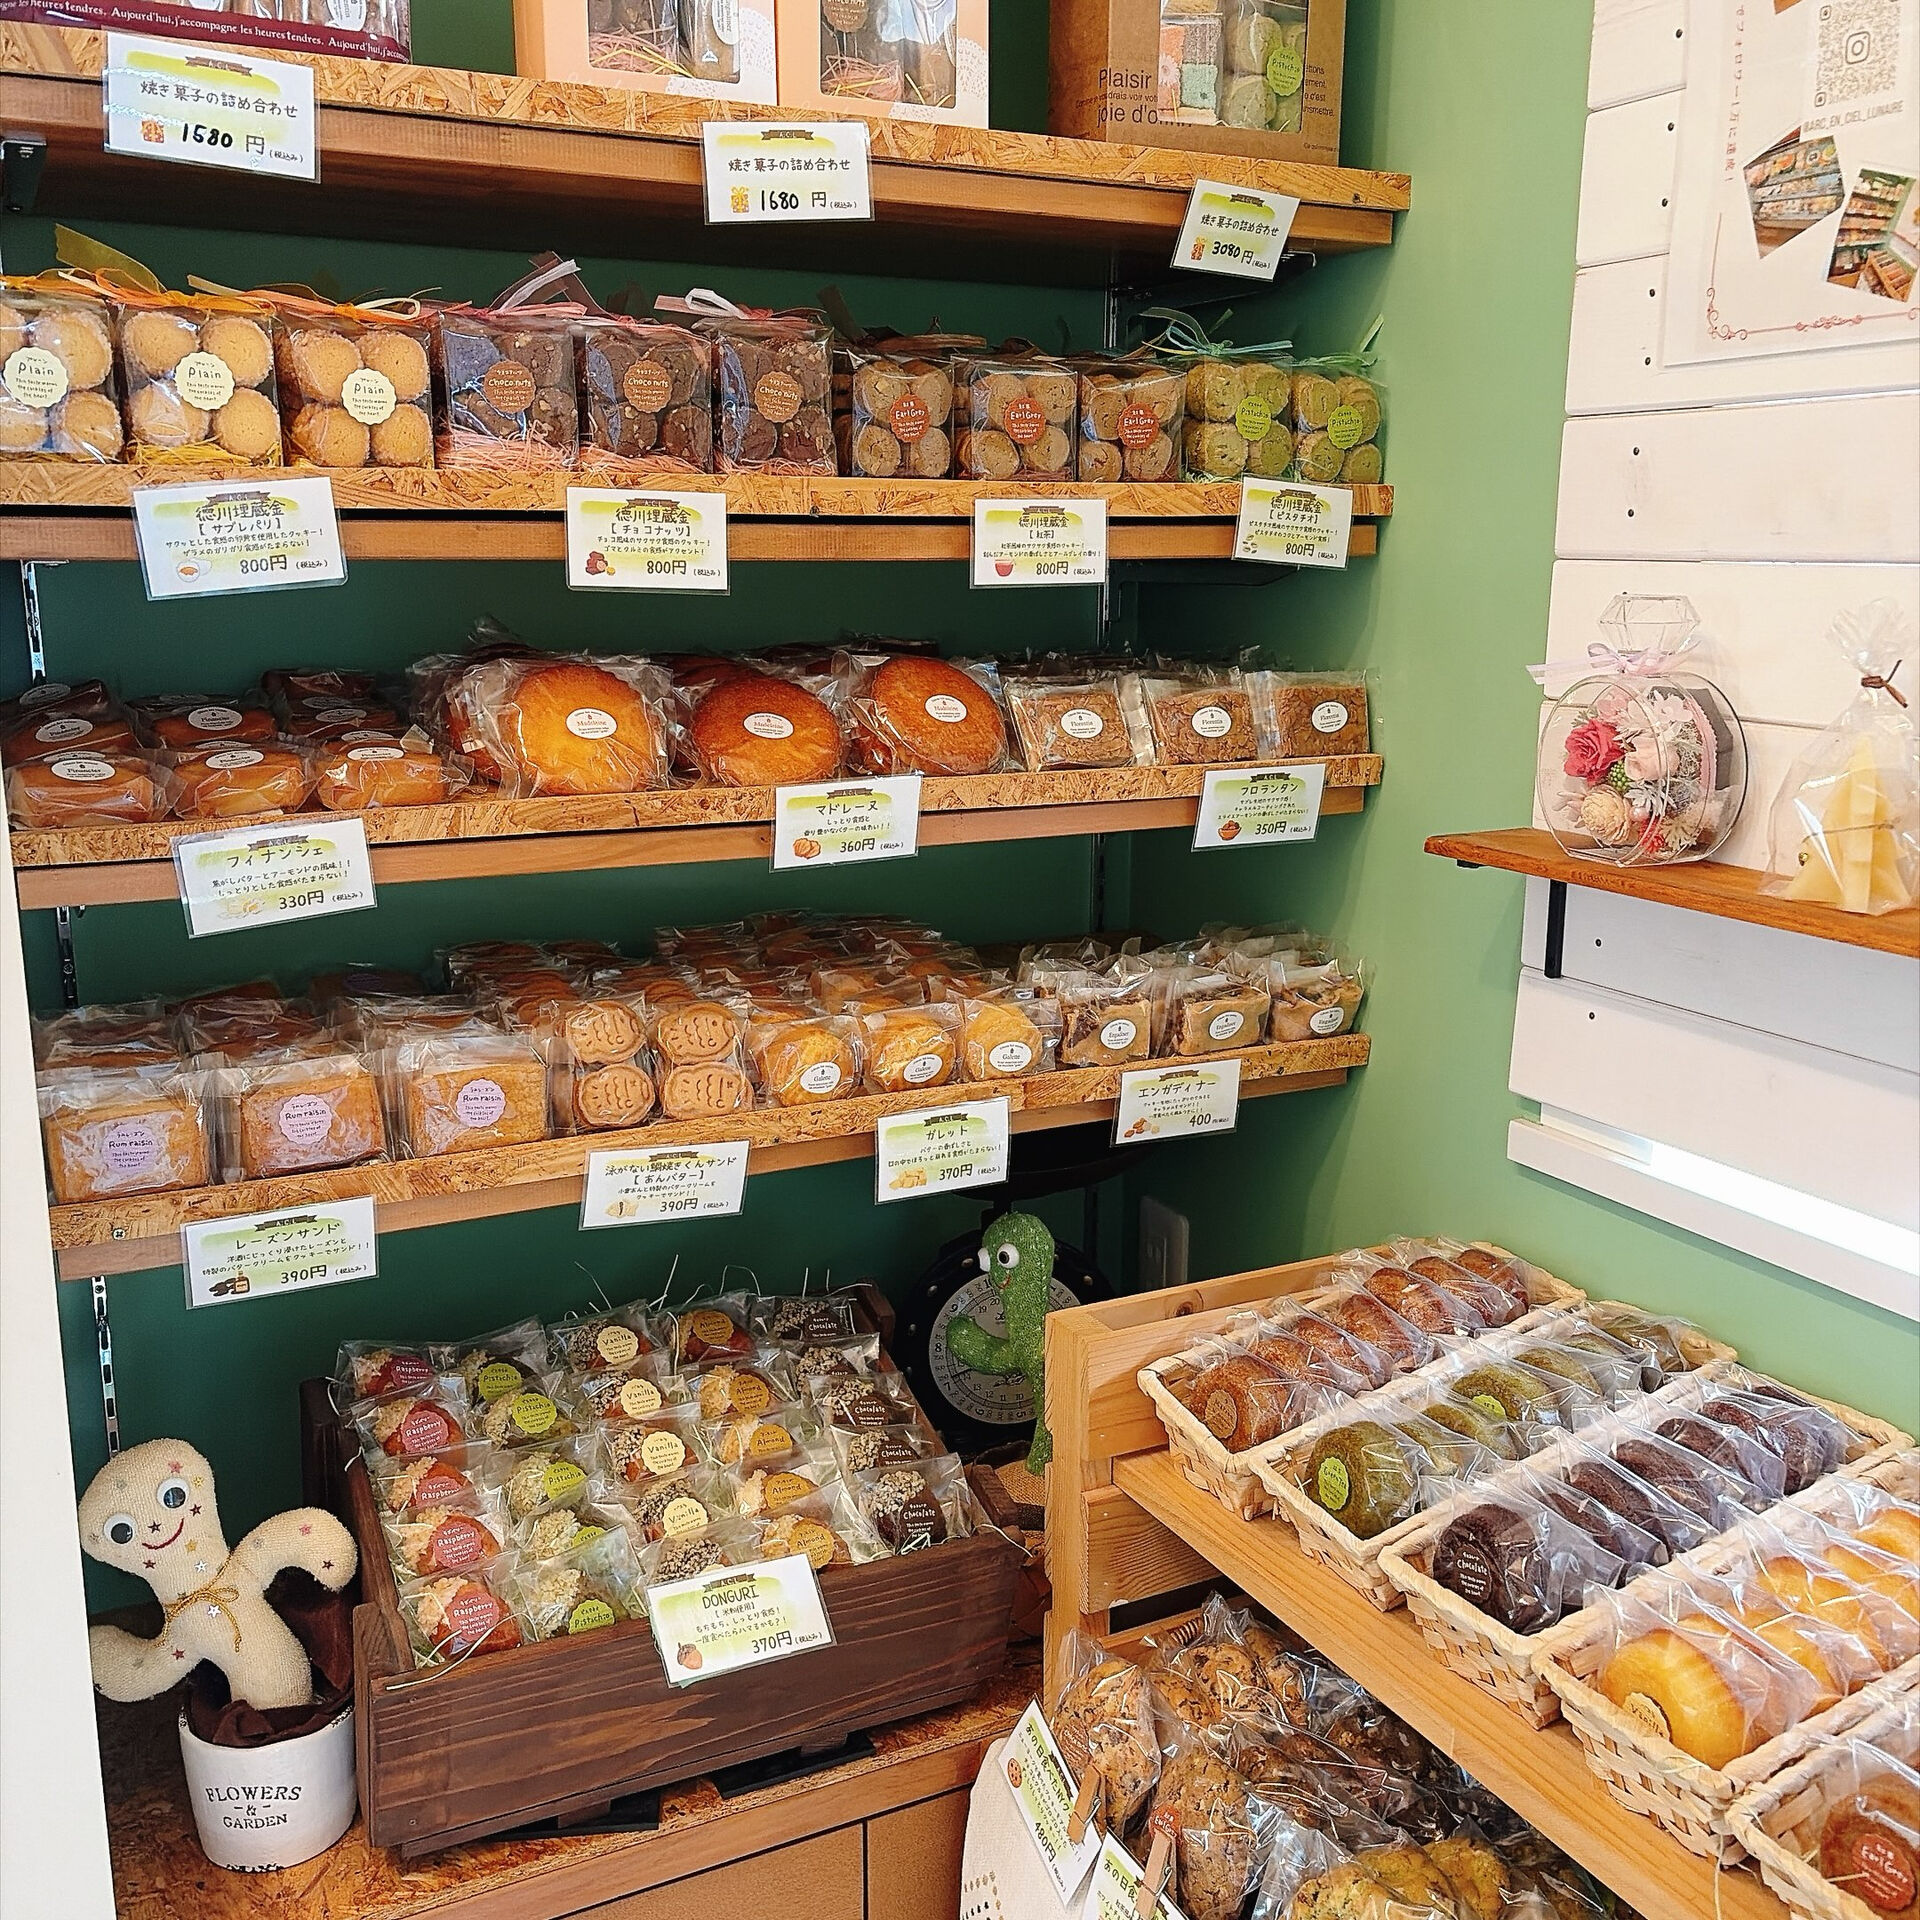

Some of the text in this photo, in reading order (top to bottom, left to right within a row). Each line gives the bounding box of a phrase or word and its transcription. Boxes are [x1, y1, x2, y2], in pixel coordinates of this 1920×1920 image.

[240, 24, 252, 35] les
[255, 27, 286, 40] heures
[286, 32, 324, 45] tendres.
[1099, 68, 1152, 90] Plaisir
[140, 81, 298, 118] 焼き菓子の詰め合わせ
[1097, 103, 1125, 128] joie
[182, 122, 233, 148] 1580
[246, 134, 265, 155] 円
[728, 157, 850, 172] 焼き菓子の詰め合わせ
[761, 190, 799, 211] 1680
[811, 191, 826, 207] 円
[1200, 214, 1279, 237] 焼き菓子の詰め合わせ
[1212, 241, 1240, 258] 3080
[1241, 250, 1254, 264] 円
[18, 362, 55, 376] Plain
[188, 366, 222, 379] Plain
[354, 382, 385, 395] Plain
[895, 409, 926, 419] Earl Grey
[1010, 411, 1042, 421] Earl Grey
[1123, 417, 1155, 427] Earl Grey
[195, 500, 286, 521] 徳川埋蔵金
[1271, 497, 1324, 514] 徳川埋蔵金
[616, 509, 691, 524] 徳川埋蔵金
[1019, 516, 1069, 528] 徳川埋蔵金
[1285, 543, 1315, 556] 800円
[240, 554, 288, 574] 800円
[646, 560, 687, 575] 800円
[1036, 561, 1069, 575] 800円
[1241, 783, 1299, 796] フロランタン
[816, 800, 879, 816] マドレーヌ
[1255, 821, 1287, 835] 350円
[840, 838, 875, 853] 360円
[227, 845, 324, 868] フィナンシェ
[279, 890, 324, 910] 330円
[1138, 1080, 1217, 1099] エンガディナー
[285, 1110, 327, 1121] Rum raisin
[1189, 1113, 1211, 1127] 400
[926, 1125, 968, 1140] ガレット
[108, 1139, 153, 1149] Rum raisin
[939, 1163, 973, 1181] 370円
[660, 1198, 698, 1212] 390円
[236, 1223, 341, 1250] レーズンサンド
[281, 1265, 327, 1284] 390円
[808, 1322, 838, 1331] Chocolate
[602, 1335, 632, 1346] Vanilla
[626, 1390, 655, 1400] Vanilla
[516, 1403, 551, 1414] Pistachio
[854, 1405, 886, 1414] Chocolate
[405, 1420, 442, 1437] Raspberry
[646, 1442, 679, 1454] Vanilla
[756, 1437, 785, 1447] Almond
[881, 1448, 912, 1458] Chocolate
[772, 1483, 802, 1495] Almond
[903, 1510, 937, 1520] Chocolate
[437, 1532, 475, 1547] Raspberry
[796, 1534, 826, 1548] Almond
[702, 1584, 760, 1609] DONGURI
[453, 1602, 494, 1618] Raspberry
[574, 1614, 611, 1629] Pistachio
[752, 1630, 792, 1654] 370円
[205, 1786, 302, 1802] FLOWERS
[223, 1814, 288, 1829] GARDEN
[1034, 1821, 1056, 1863] 480円
[1861, 1845, 1885, 1868] Earl
